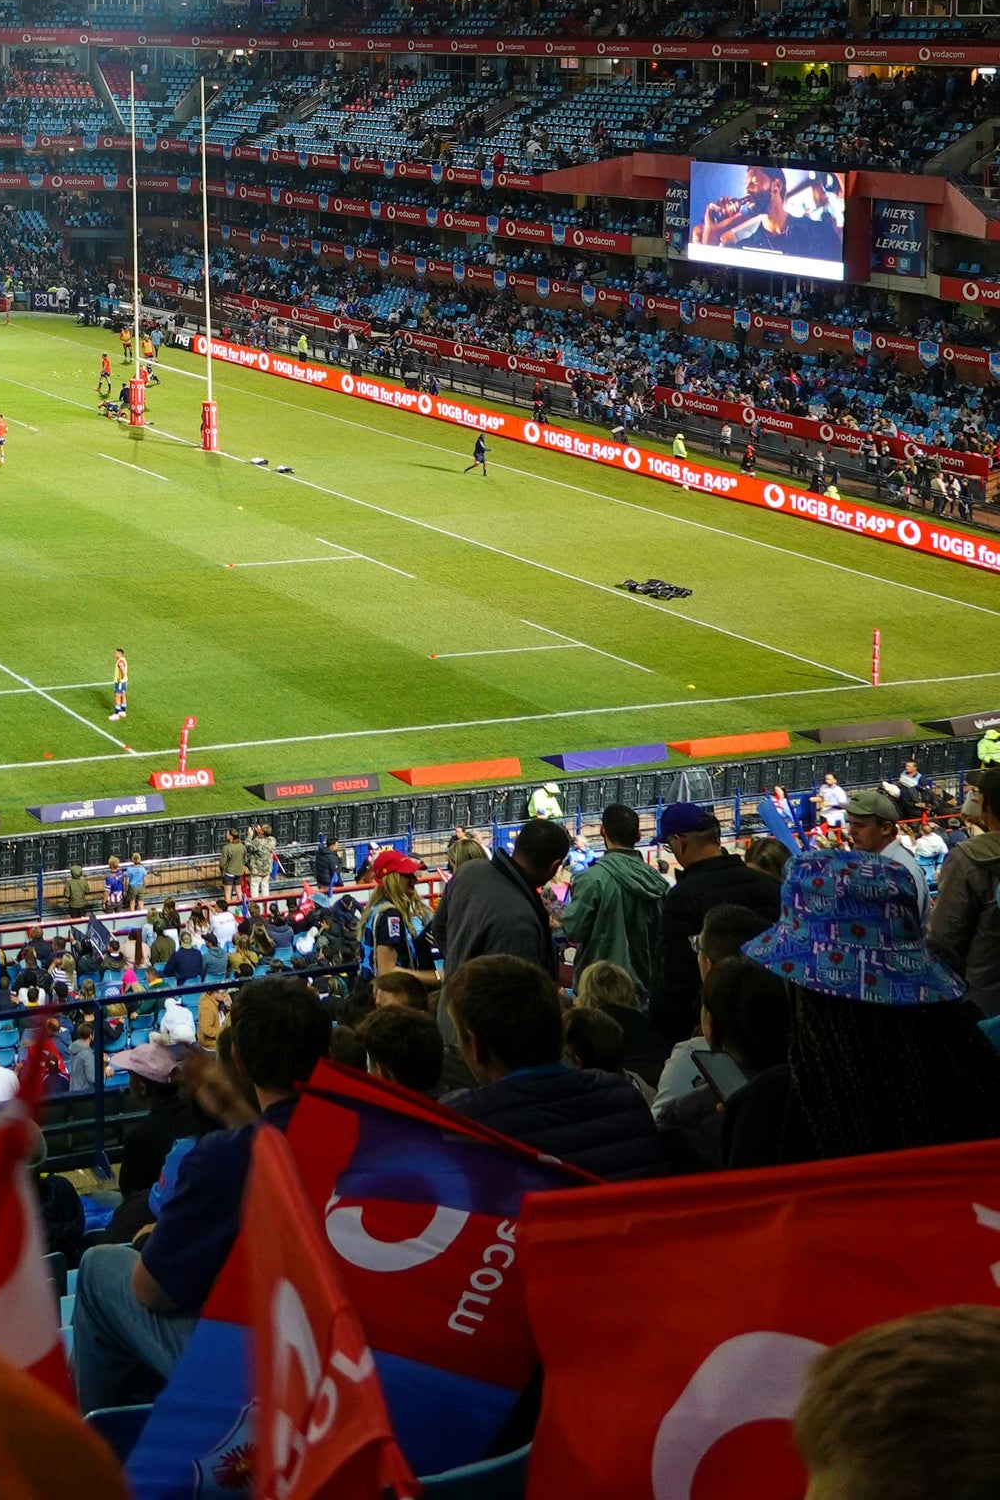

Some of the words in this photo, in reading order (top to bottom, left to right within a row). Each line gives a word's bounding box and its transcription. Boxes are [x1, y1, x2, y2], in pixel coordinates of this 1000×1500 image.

[248, 190, 266, 198] vodacom
[294, 196, 313, 204] vodacom
[343, 203, 365, 211] vodacom
[397, 211, 420, 219] vodacom
[882, 208, 915, 220] HIER'S
[454, 218, 480, 227] vodacom
[517, 227, 545, 236] vodacom
[890, 224, 908, 235] DIT
[585, 236, 615, 246] vodacom
[875, 239, 922, 252] LEKKER!
[981, 290, 1000, 299] vod
[762, 320, 788, 329] vodacom
[823, 331, 849, 340] vodacom
[887, 342, 915, 351] vodacom
[462, 349, 491, 363] vodacom
[955, 353, 985, 363] vodacom
[273, 360, 293, 375] 10GB
[292, 365, 306, 378] for
[517, 361, 547, 375] vodacom
[356, 382, 379, 398] 10GB
[379, 388, 394, 401] for
[684, 397, 719, 414] vodacom
[437, 402, 462, 420] 10GB
[462, 409, 478, 423] for
[757, 415, 793, 430] vodacom
[543, 430, 572, 450] 10GB
[571, 438, 591, 453] for
[835, 431, 868, 445] vodac
[648, 458, 680, 480] 10GB
[681, 467, 701, 484] for
[789, 493, 828, 519] 10GB
[829, 505, 853, 525] for
[930, 533, 975, 560] 10GB
[174, 772, 197, 786] 22m
[277, 784, 313, 796] ISUZU
[332, 779, 369, 791] ISUZU
[61, 807, 95, 820] AFGRI
[114, 803, 147, 814] AFGRI
